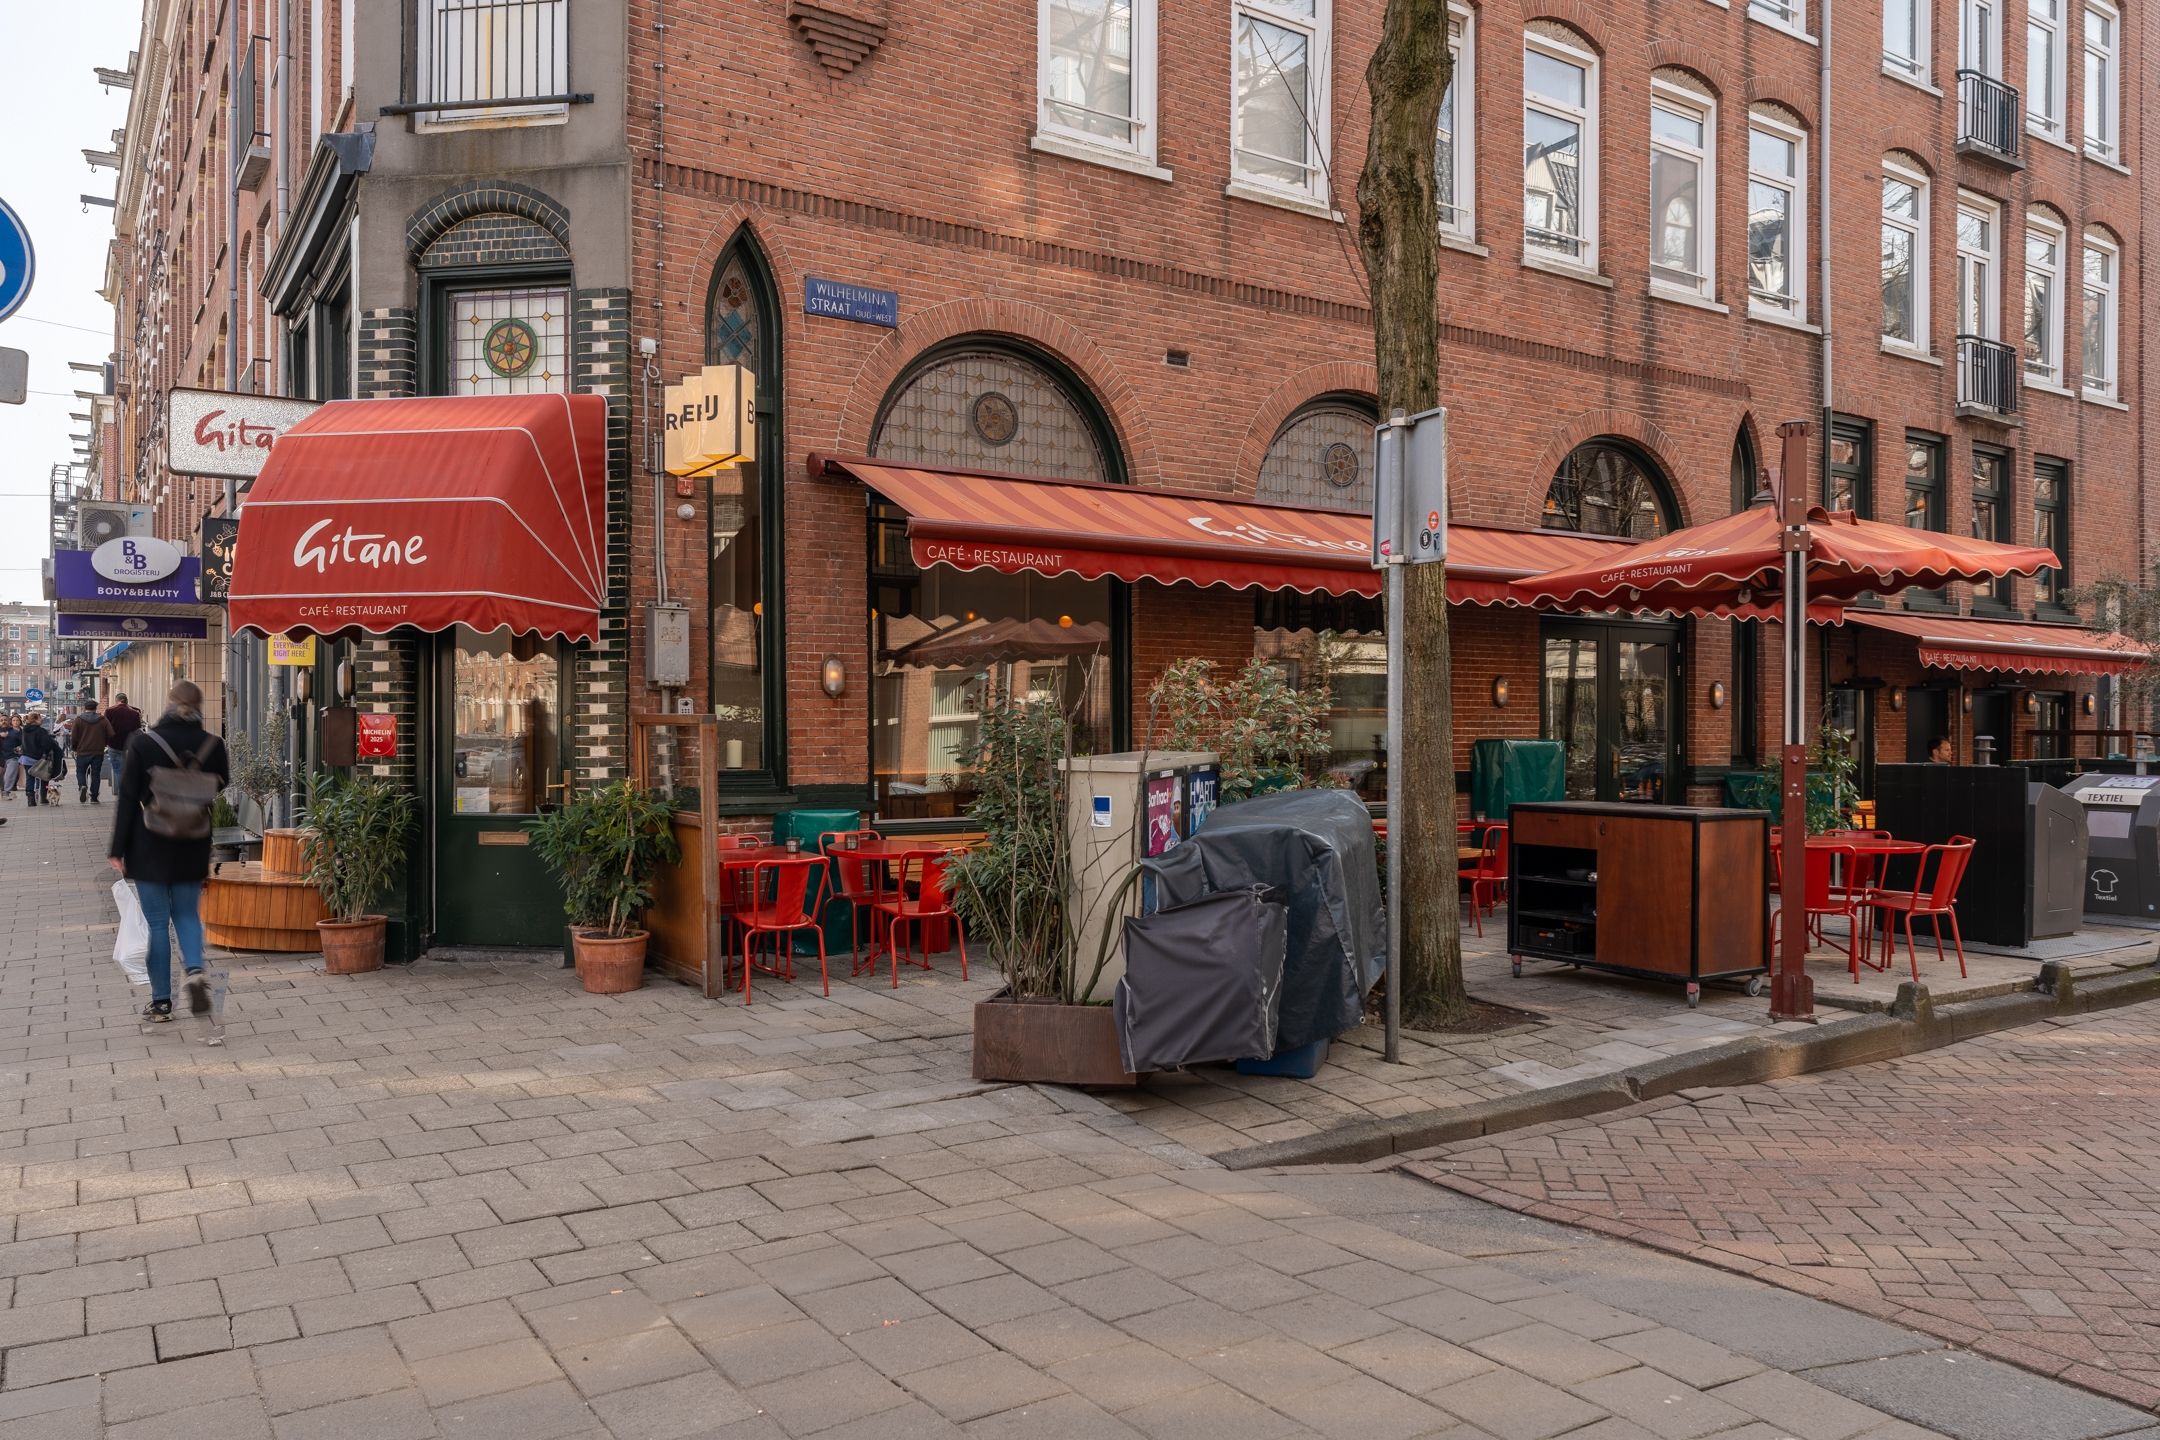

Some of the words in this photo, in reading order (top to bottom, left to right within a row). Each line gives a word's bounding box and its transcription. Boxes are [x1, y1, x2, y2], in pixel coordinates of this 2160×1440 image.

[816, 283, 888, 306] WILHELMINA
[811, 298, 851, 315] STRAAT
[855, 309, 892, 323] OUD-WEST
[293, 518, 428, 574] Gitane
[927, 545, 966, 561] CAFÉ
[974, 549, 1063, 567] RESTAURANT
[113, 568, 160, 577] DROGISTERIJ
[1600, 569, 1625, 583] CAFÉ
[1630, 563, 1693, 579] RESTAURANT
[97, 586, 180, 598] BODY&BEAUTY
[299, 604, 329, 617] CAFÉ
[335, 604, 408, 616] RESTAURANT
[72, 629, 129, 638] DROGISTERIJ
[131, 631, 193, 639] BODY&BEAUTY
[273, 649, 290, 657] RIGHT
[291, 650, 306, 658] HERE
[2087, 793, 2125, 803] TEXTIEL
[2094, 893, 2118, 902] Textiel
